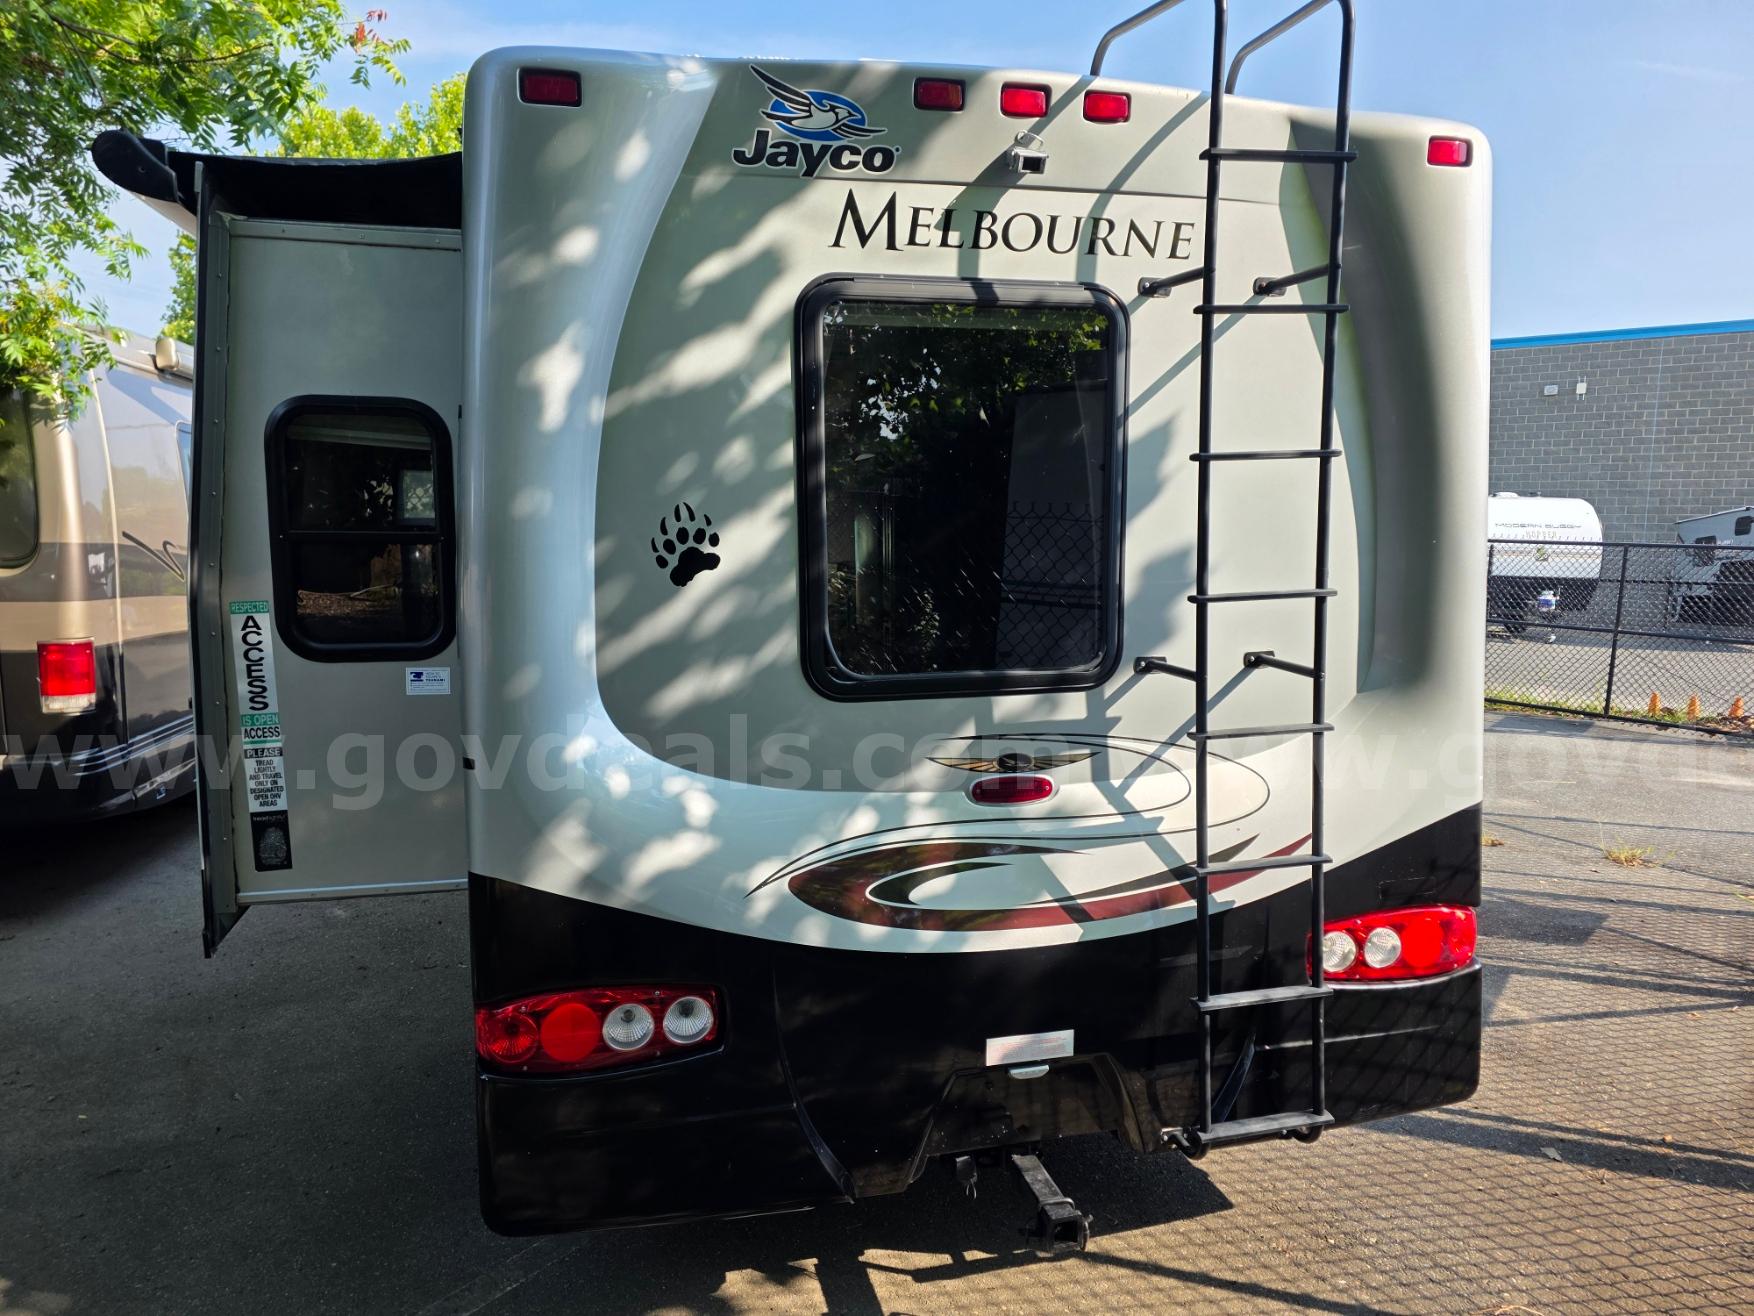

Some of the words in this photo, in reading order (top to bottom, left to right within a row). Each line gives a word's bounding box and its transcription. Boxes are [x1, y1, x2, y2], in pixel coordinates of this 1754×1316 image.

[733, 129, 900, 177] Jayco
[240, 615, 270, 712] ACCESS
[243, 715, 252, 725] IS
[254, 714, 280, 725] OPEN
[244, 726, 281, 740] ACCESS
[247, 748, 282, 758] PLEASE
